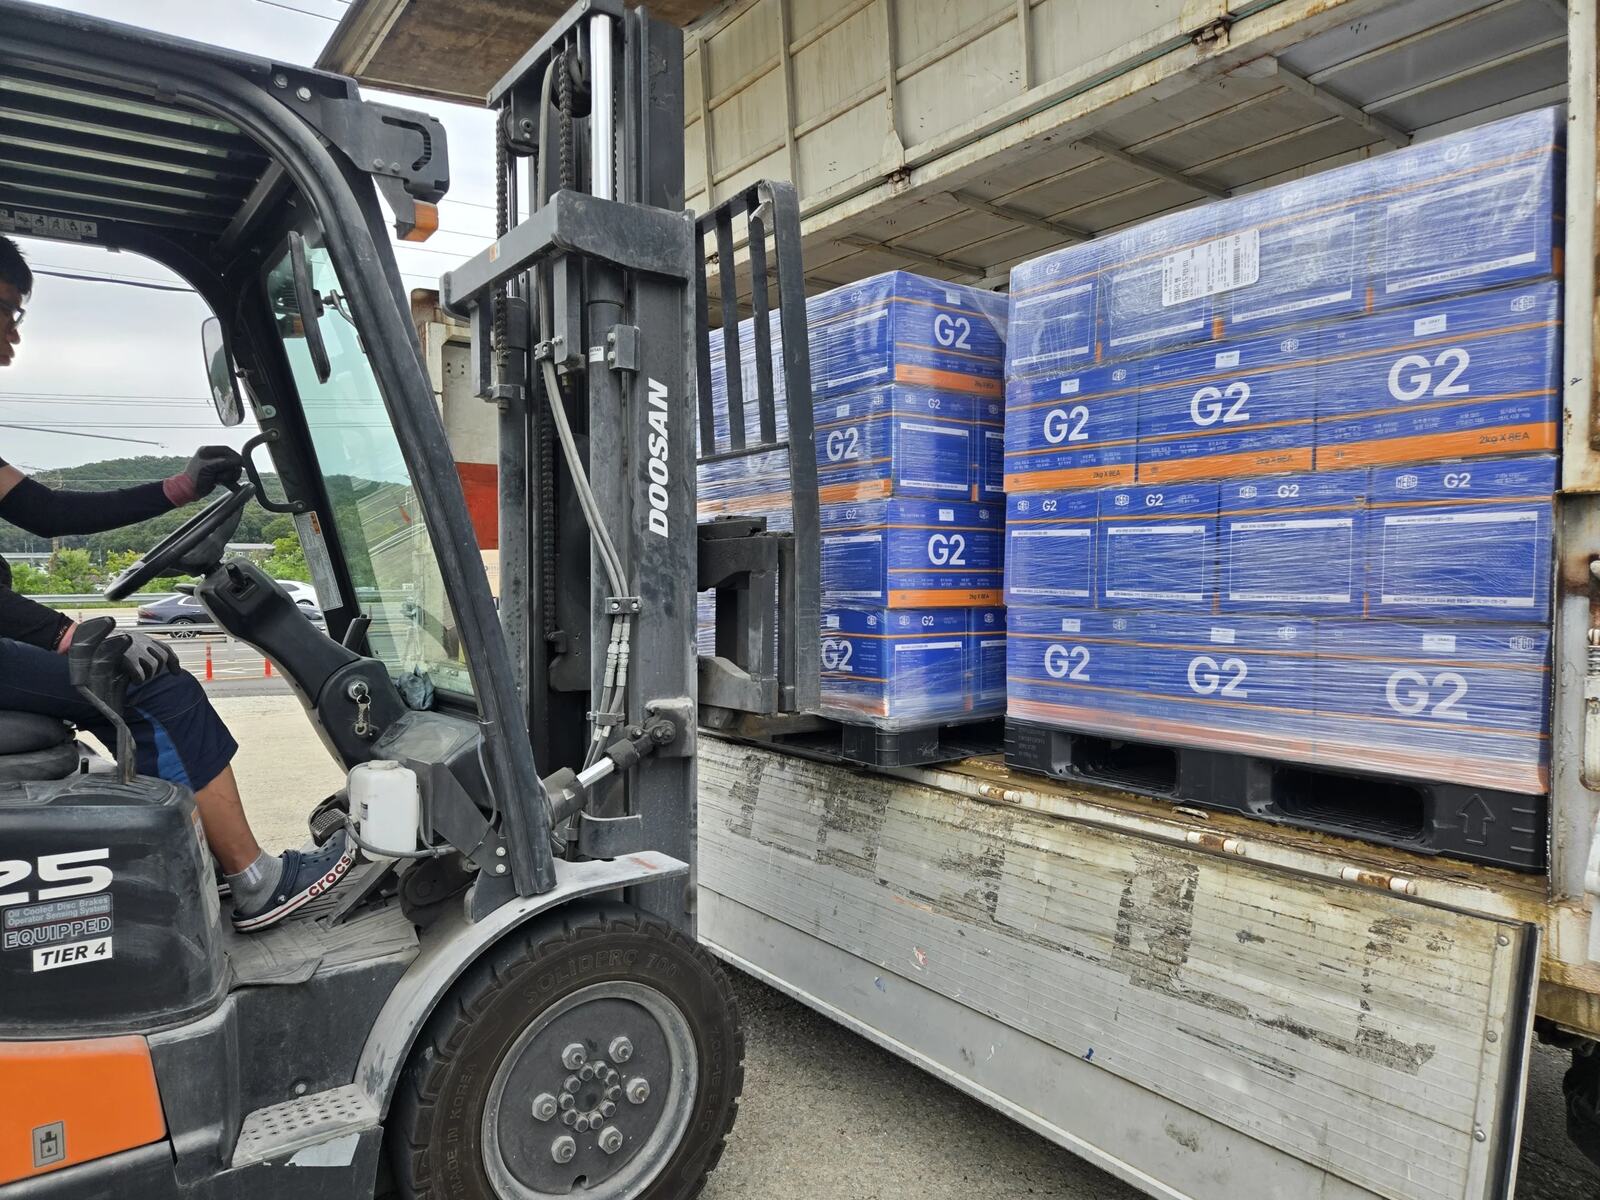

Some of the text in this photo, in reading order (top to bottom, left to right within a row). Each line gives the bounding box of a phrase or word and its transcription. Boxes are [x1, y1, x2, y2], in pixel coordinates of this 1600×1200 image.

[934, 313, 972, 351] G2
[1388, 348, 1471, 402] G2
[927, 398, 941, 410] G2
[1190, 382, 1251, 426] G2
[1043, 405, 1090, 444] G2
[648, 377, 669, 539] DOOSAN
[826, 427, 860, 462] G2
[1278, 484, 1300, 498] G2
[1443, 472, 1472, 489] G2
[1042, 499, 1057, 512] G2
[1145, 494, 1164, 507] G2
[928, 533, 966, 566] G2
[922, 615, 935, 627] G2
[821, 639, 853, 672] G2
[1044, 644, 1091, 682] G2
[1187, 656, 1249, 699] G2
[1386, 668, 1469, 721] G2
[309, 856, 351, 897] crocs
[8, 897, 108, 918] Oil Cooled Disc Brakes
[8, 904, 109, 926] Operator Sensing System
[4, 916, 111, 948] EQUIPPED
[41, 941, 106, 966] TIER 4
